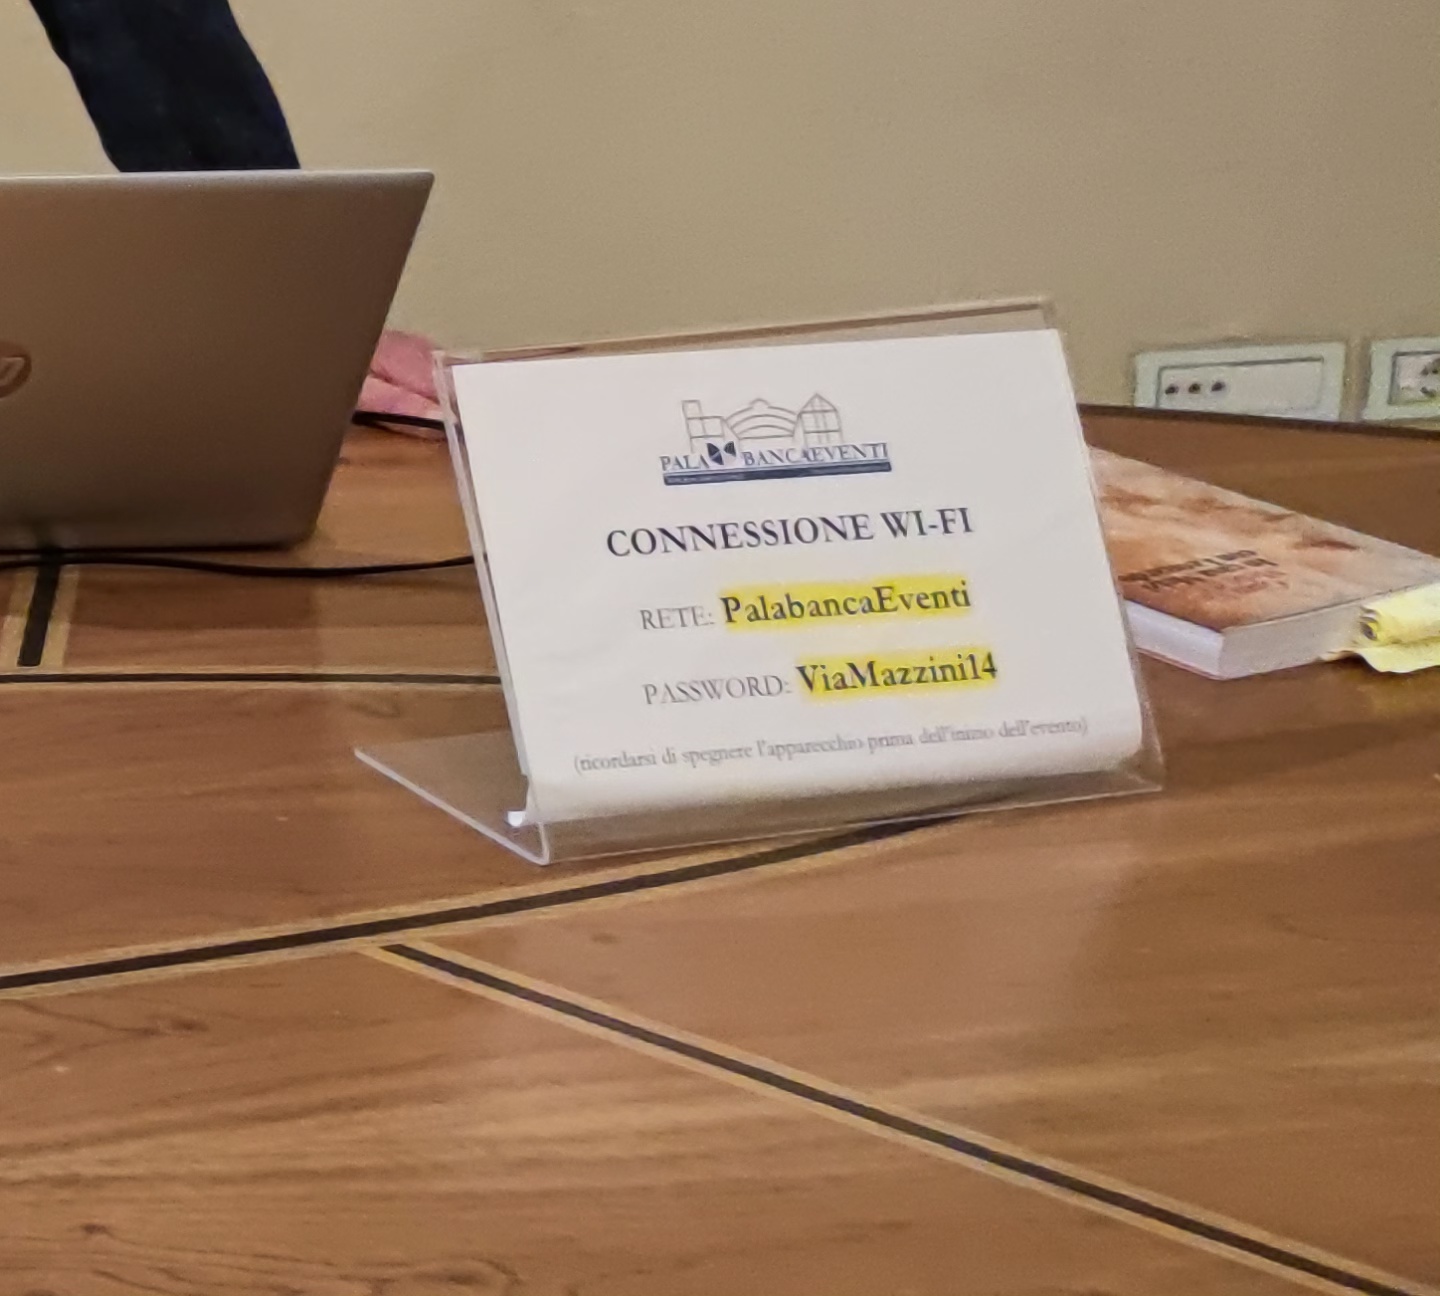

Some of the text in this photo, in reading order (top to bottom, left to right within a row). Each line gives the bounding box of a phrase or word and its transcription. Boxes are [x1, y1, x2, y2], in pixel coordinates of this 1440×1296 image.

[606, 507, 974, 557] CONNESSIONE WI-FI
[640, 579, 972, 630] RETE: PalabancaEventi
[642, 651, 999, 705] PASSWORD: ViaMazzini14
[662, 747, 677, 765] di
[681, 747, 753, 769] spegnere
